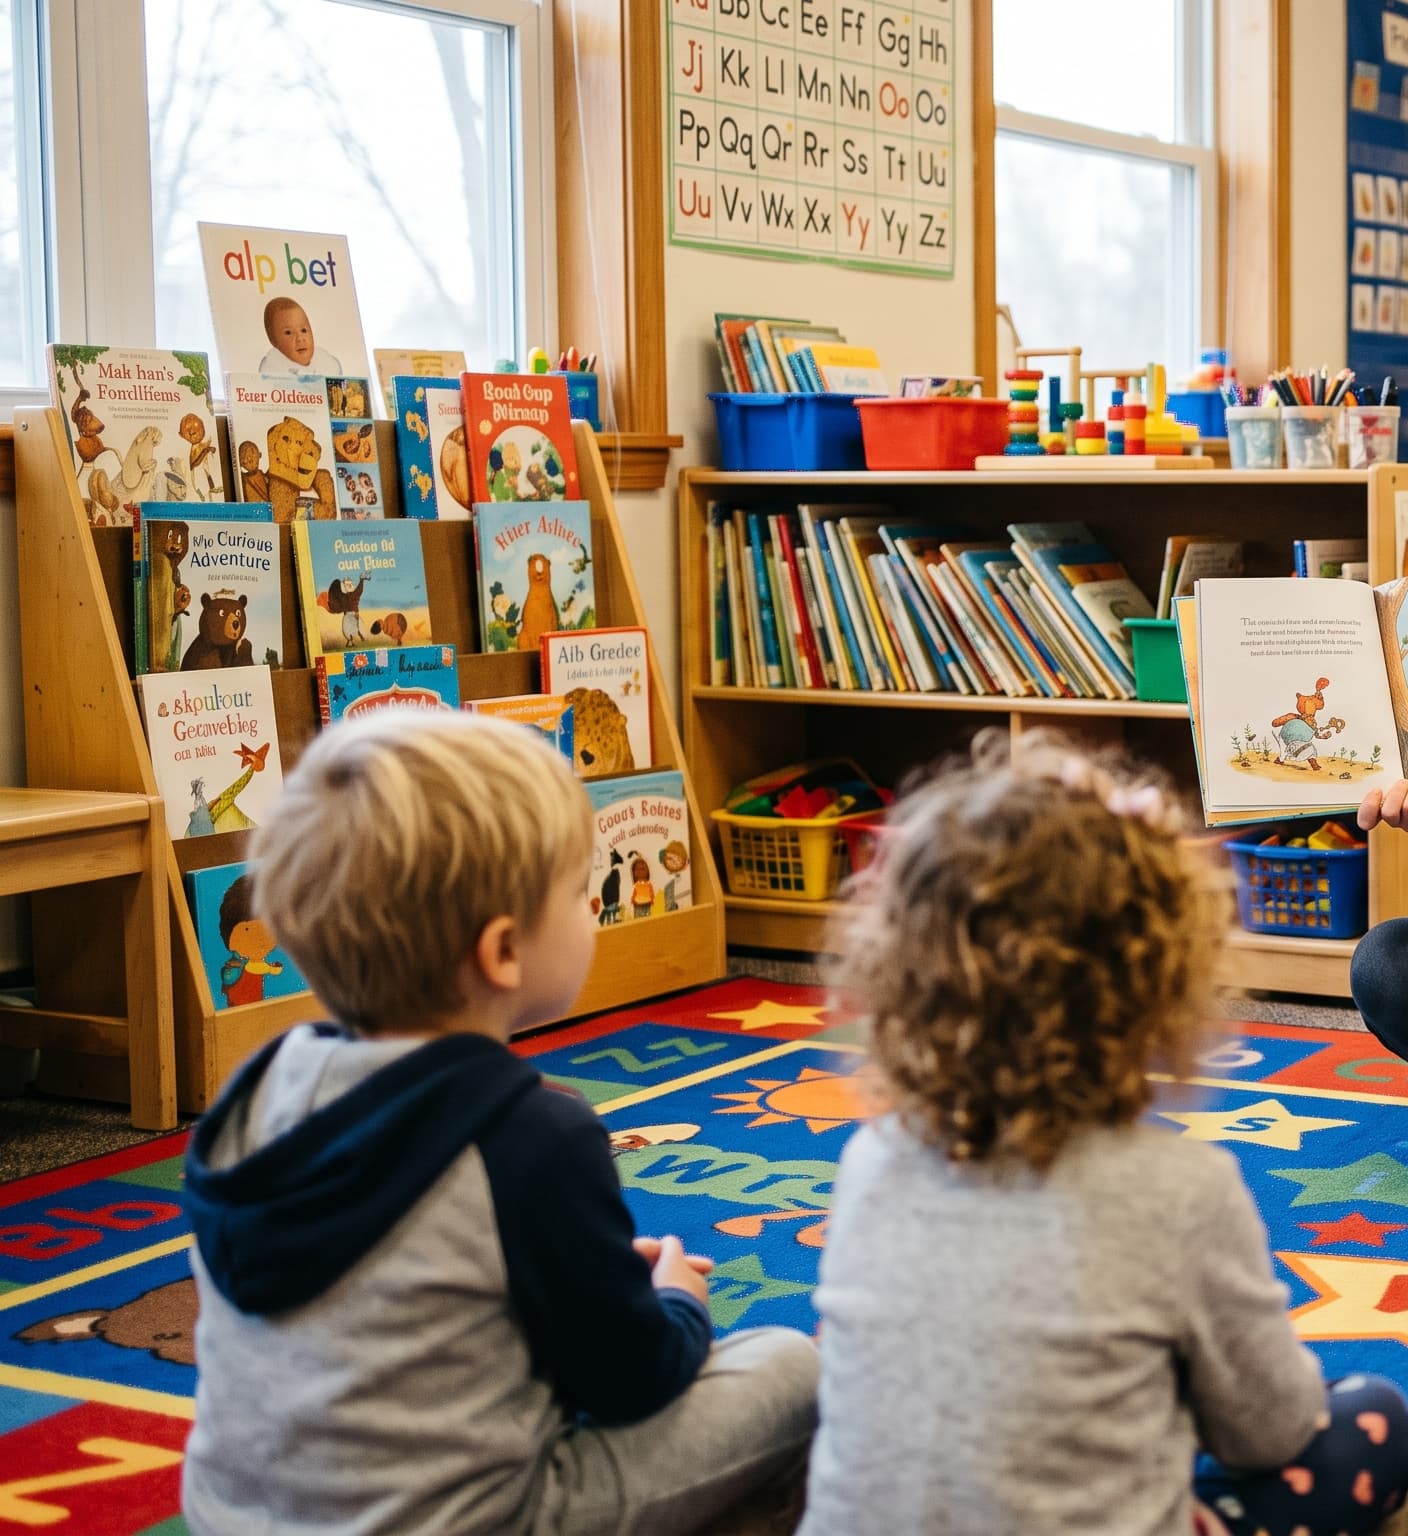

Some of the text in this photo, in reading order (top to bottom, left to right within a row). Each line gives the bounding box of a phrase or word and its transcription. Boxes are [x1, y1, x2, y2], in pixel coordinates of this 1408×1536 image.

[801, 0, 828, 36] Ee
[842, 8, 865, 46] Ff
[878, 17, 911, 68] Gg
[919, 25, 947, 65] Hh
[682, 40, 703, 93] Jj
[721, 47, 750, 88] Kk
[765, 56, 785, 95] Ll
[840, 73, 870, 112] Nn
[879, 82, 910, 119] Oo
[916, 90, 946, 126] Oo
[679, 109, 710, 161] Pp
[719, 116, 756, 170] Qq
[804, 131, 829, 168] Rr
[842, 139, 868, 175] Ss
[883, 145, 906, 181] Tt
[918, 150, 946, 187] Uu
[679, 178, 946, 255] Uu Vv Wx Xx Yy Yy Zz
[224, 239, 337, 294] alp bet
[98, 362, 175, 381] Mak han's
[190, 551, 271, 571] Adventure
